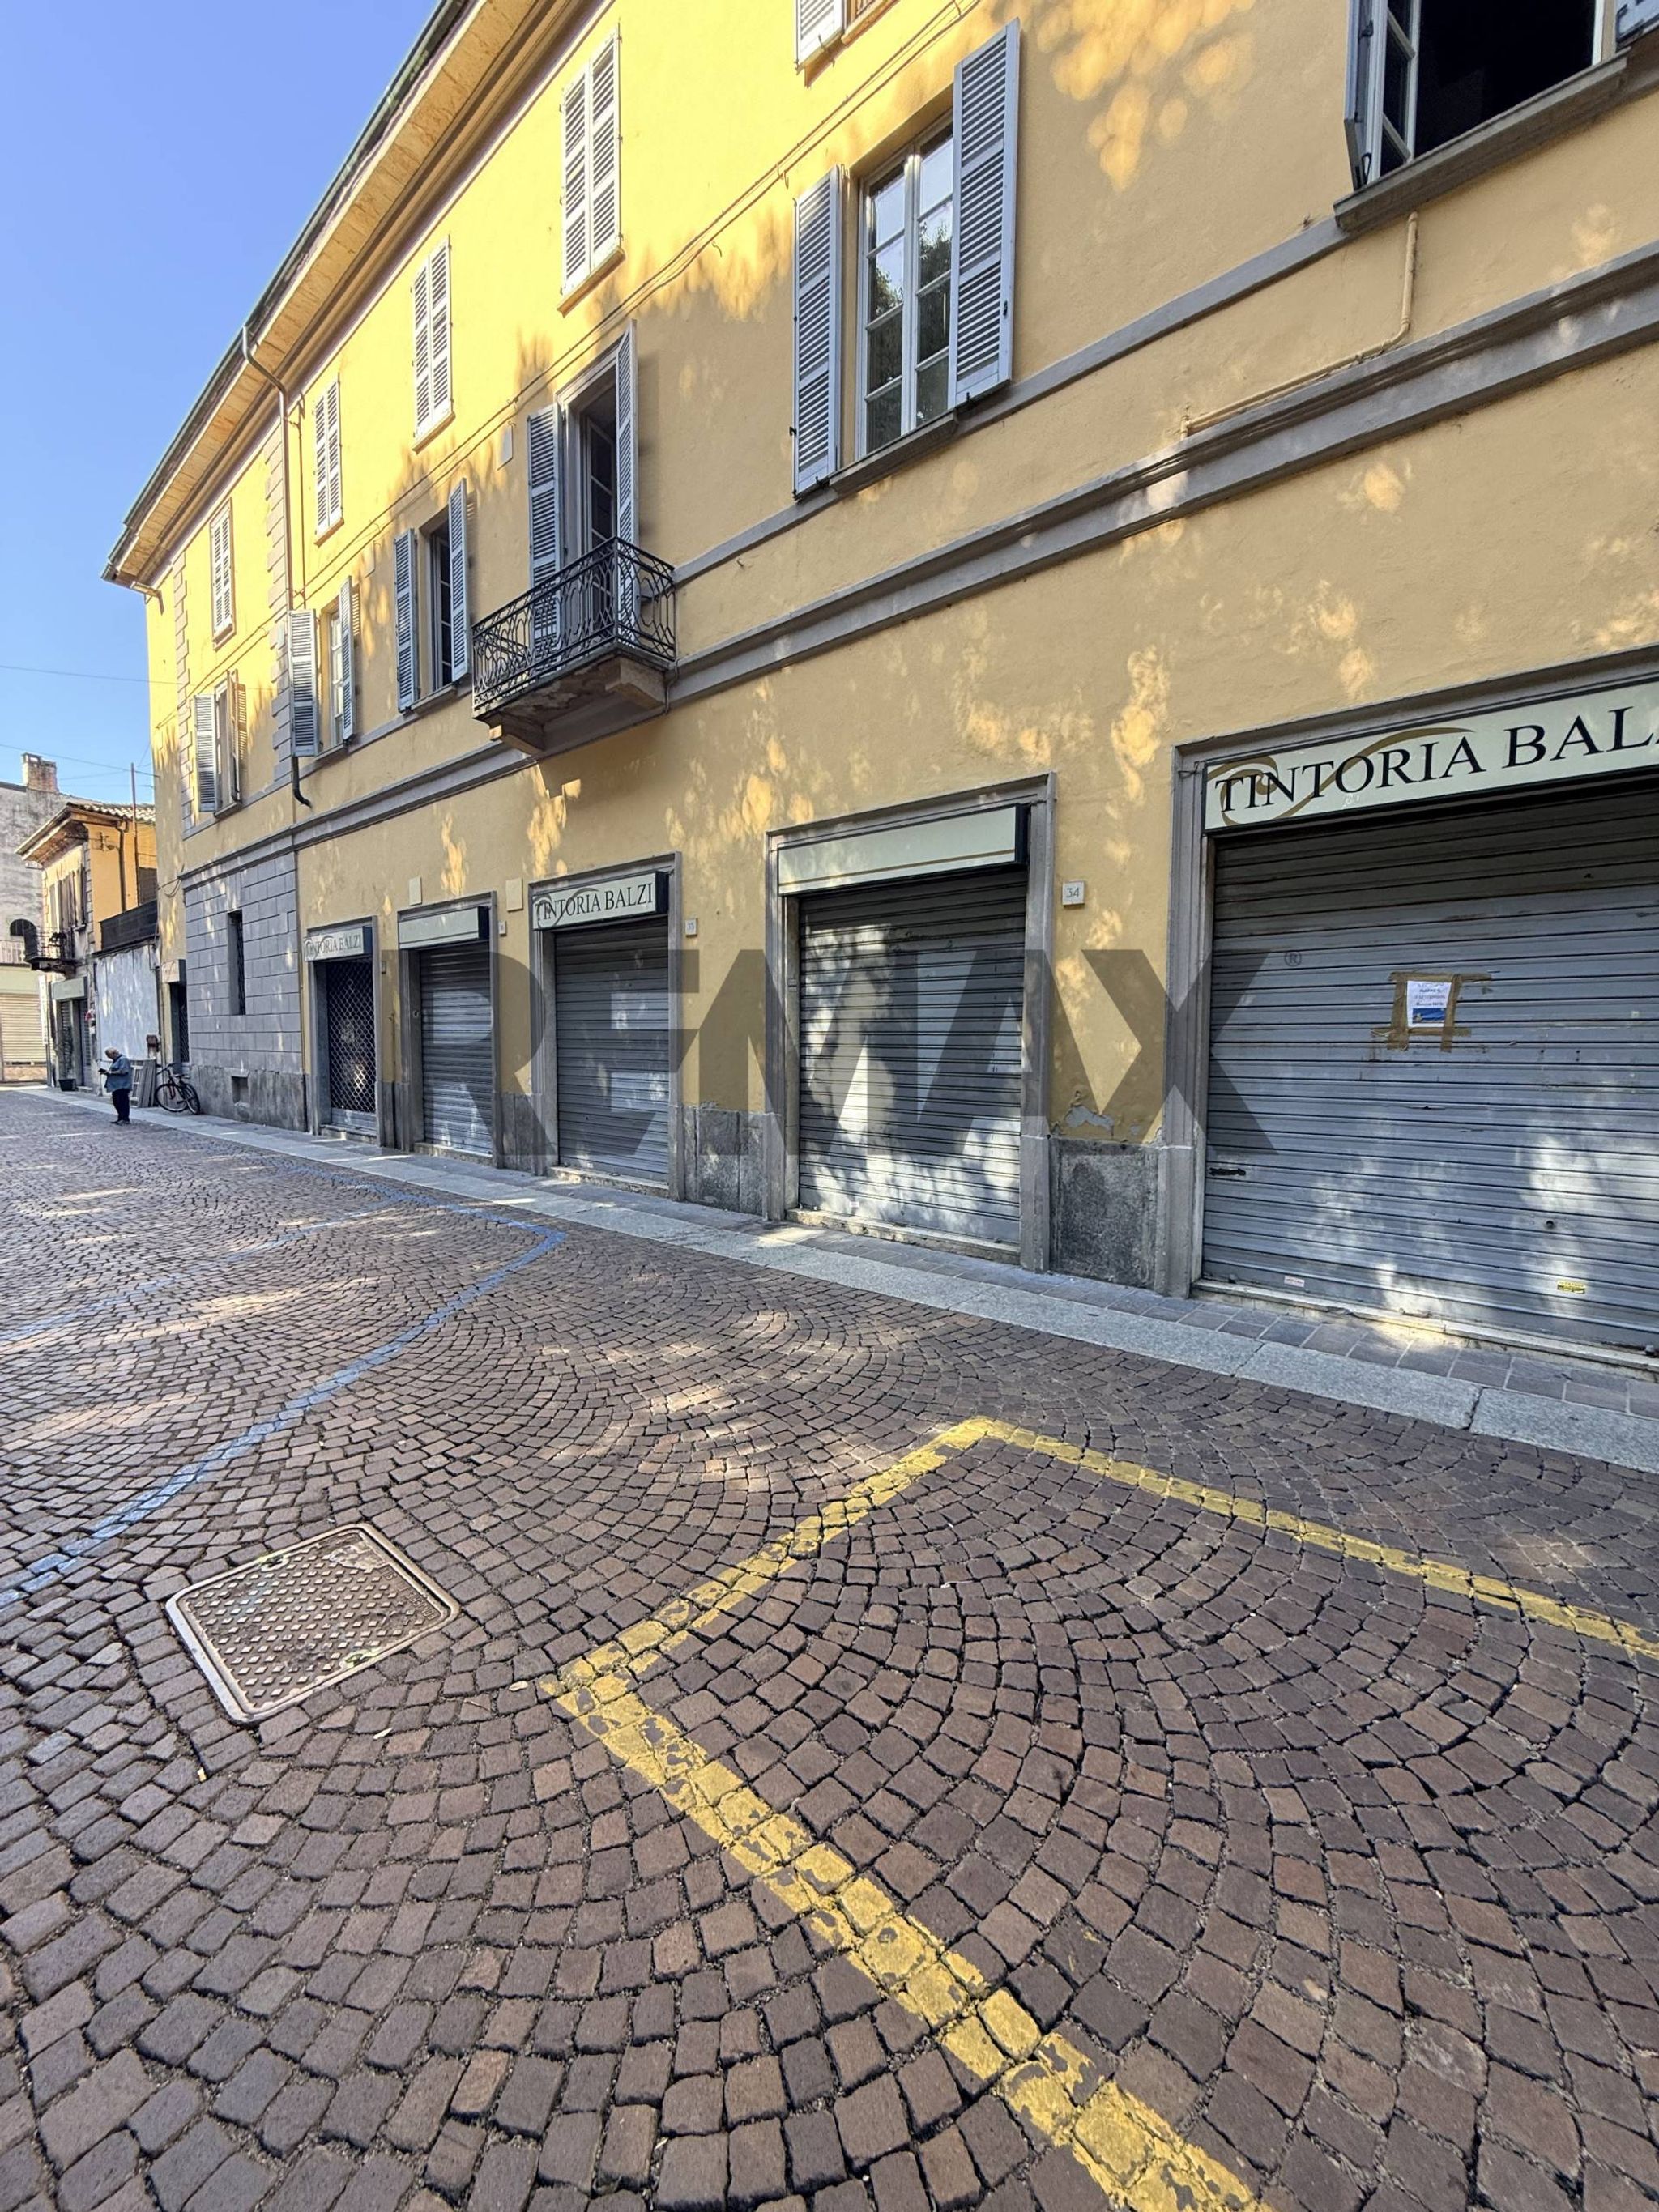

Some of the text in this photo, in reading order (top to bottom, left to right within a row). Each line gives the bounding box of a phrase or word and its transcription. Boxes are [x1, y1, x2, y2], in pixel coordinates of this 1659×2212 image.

[1215, 705, 1659, 813] TINTORIA BAL
[535, 883, 654, 921] TINTORIA BALZI
[1065, 887, 1080, 898] 34
[339, 935, 361, 951] BALZI
